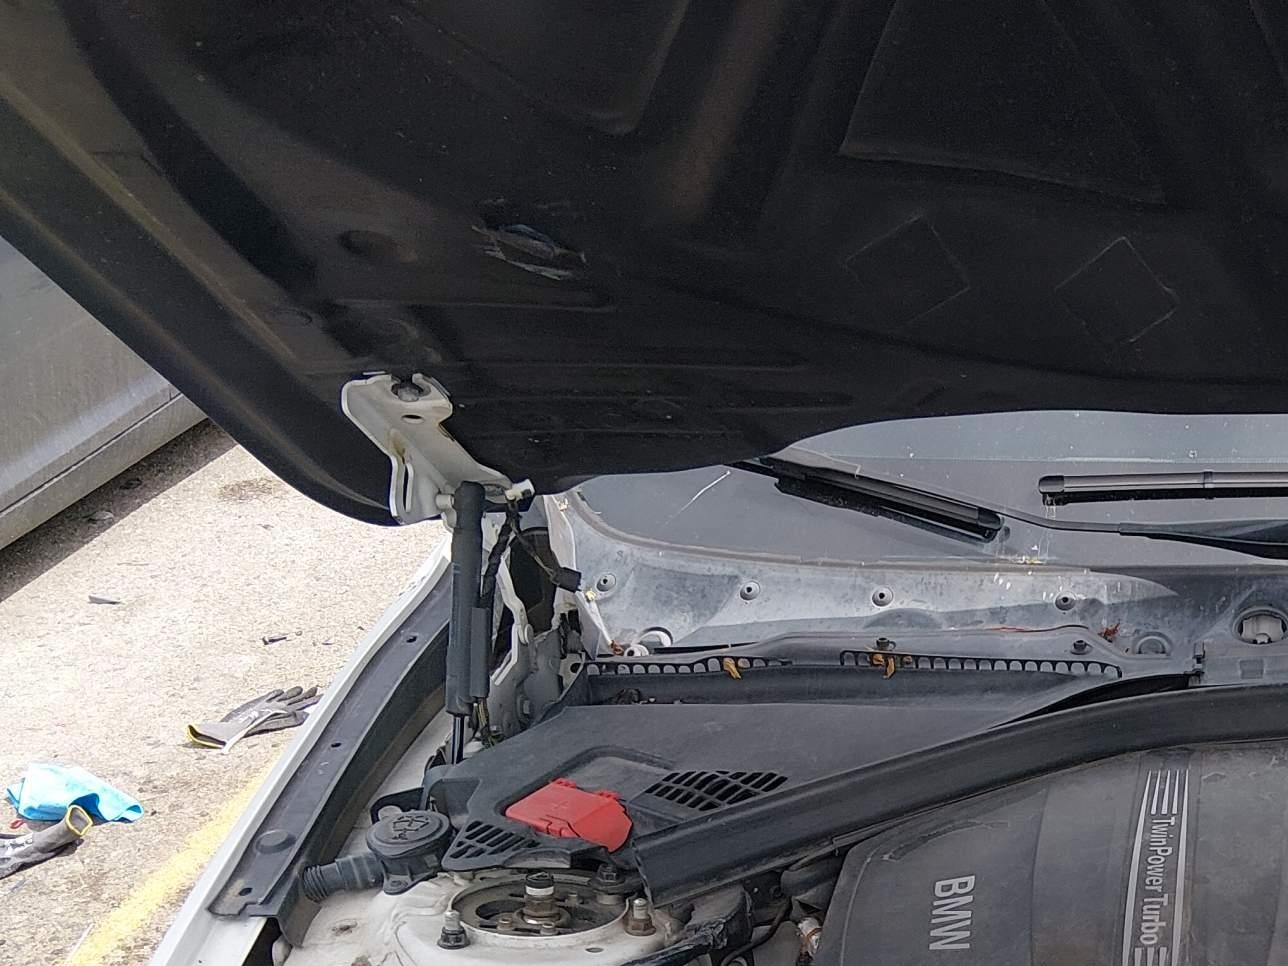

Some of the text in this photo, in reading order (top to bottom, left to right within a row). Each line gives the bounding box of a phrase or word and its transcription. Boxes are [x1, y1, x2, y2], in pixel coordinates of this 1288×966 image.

[929, 875, 975, 950] BMW
[1139, 816, 1176, 945] TwinPower Turbo
